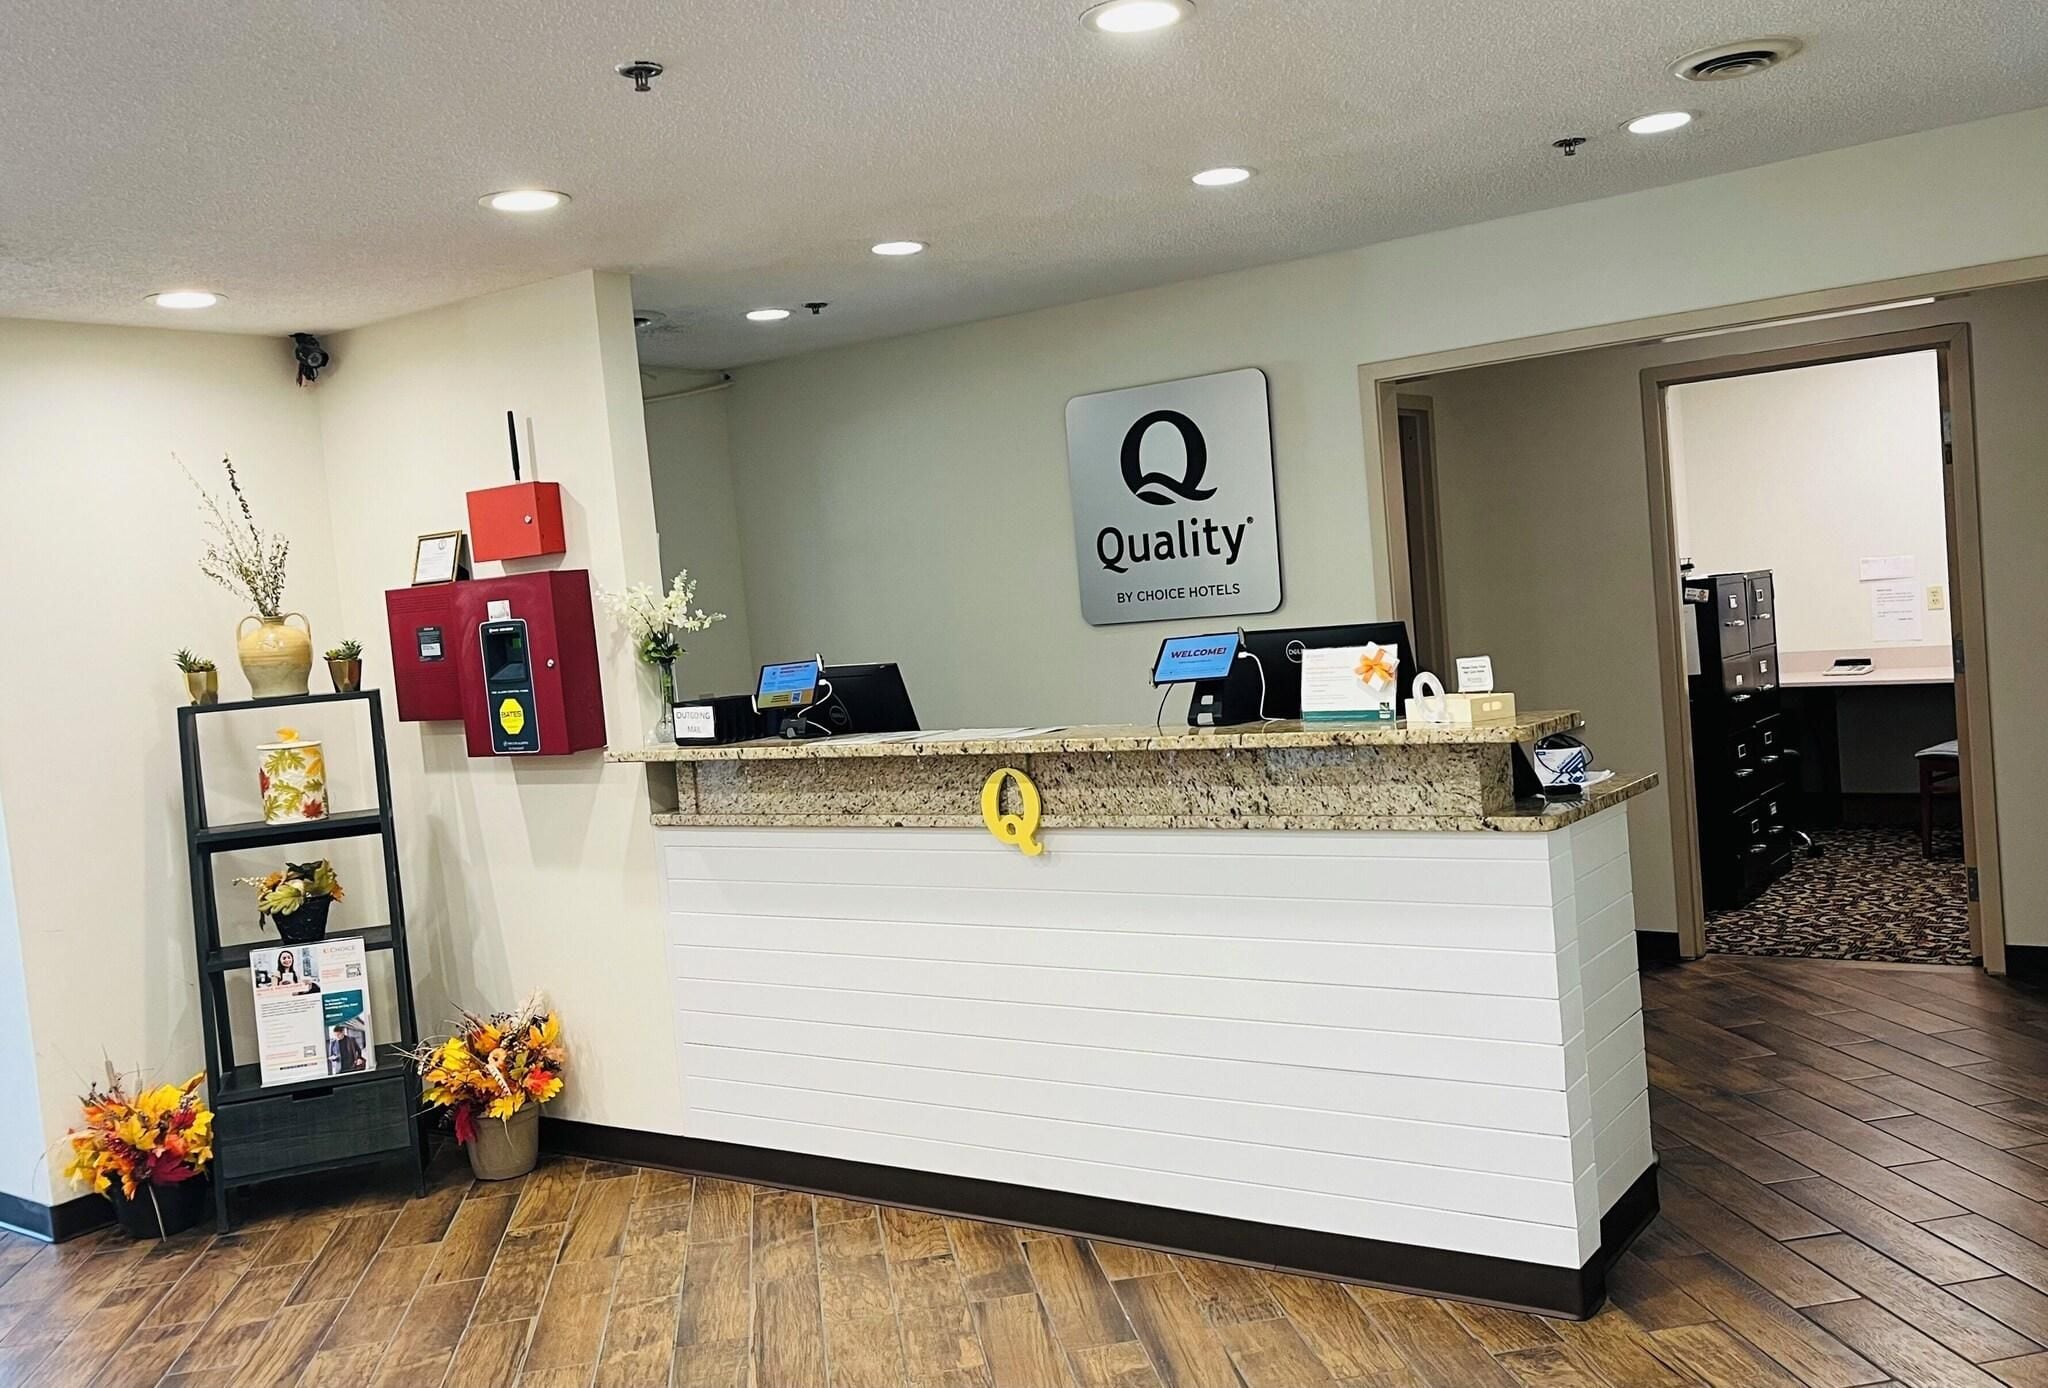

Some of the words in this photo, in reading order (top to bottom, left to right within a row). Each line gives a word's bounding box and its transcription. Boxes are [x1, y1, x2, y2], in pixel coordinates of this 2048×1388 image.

[1120, 409, 1218, 506] Q
[1117, 592, 1133, 604] BY
[1137, 587, 1185, 602] CHOICE
[1189, 583, 1241, 598] HOTELS
[1171, 647, 1227, 659] WELCOME!
[501, 710, 522, 718] BATES
[676, 711, 711, 720] OUTGOING
[981, 768, 1042, 856] Q
